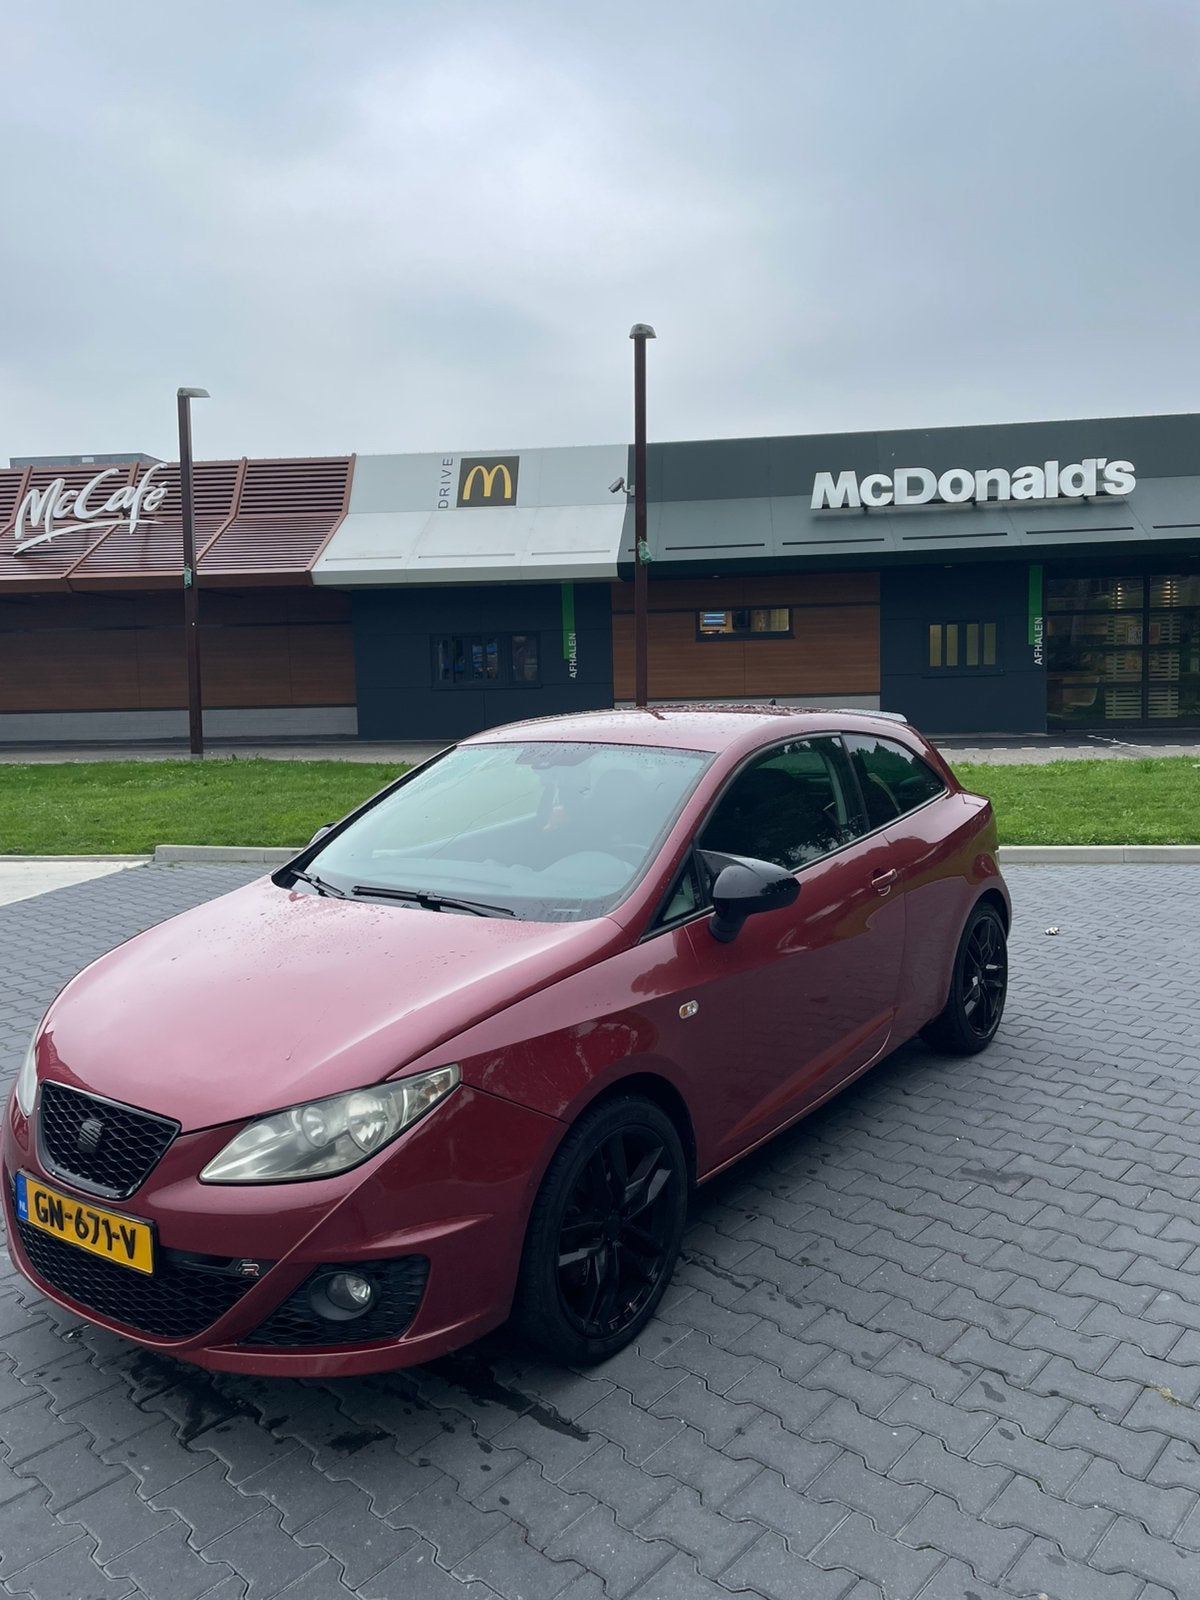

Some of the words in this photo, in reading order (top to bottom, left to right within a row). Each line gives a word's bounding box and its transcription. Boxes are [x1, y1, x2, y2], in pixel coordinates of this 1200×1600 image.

[14, 463, 169, 543] McCafé
[438, 457, 453, 509] DRIVE
[810, 458, 1136, 509] McDonald's
[569, 633, 577, 678] AFHALEN
[1033, 617, 1043, 665] AFHALEN
[19, 1200, 27, 1212] NL
[34, 1191, 136, 1260] GN-671-V
